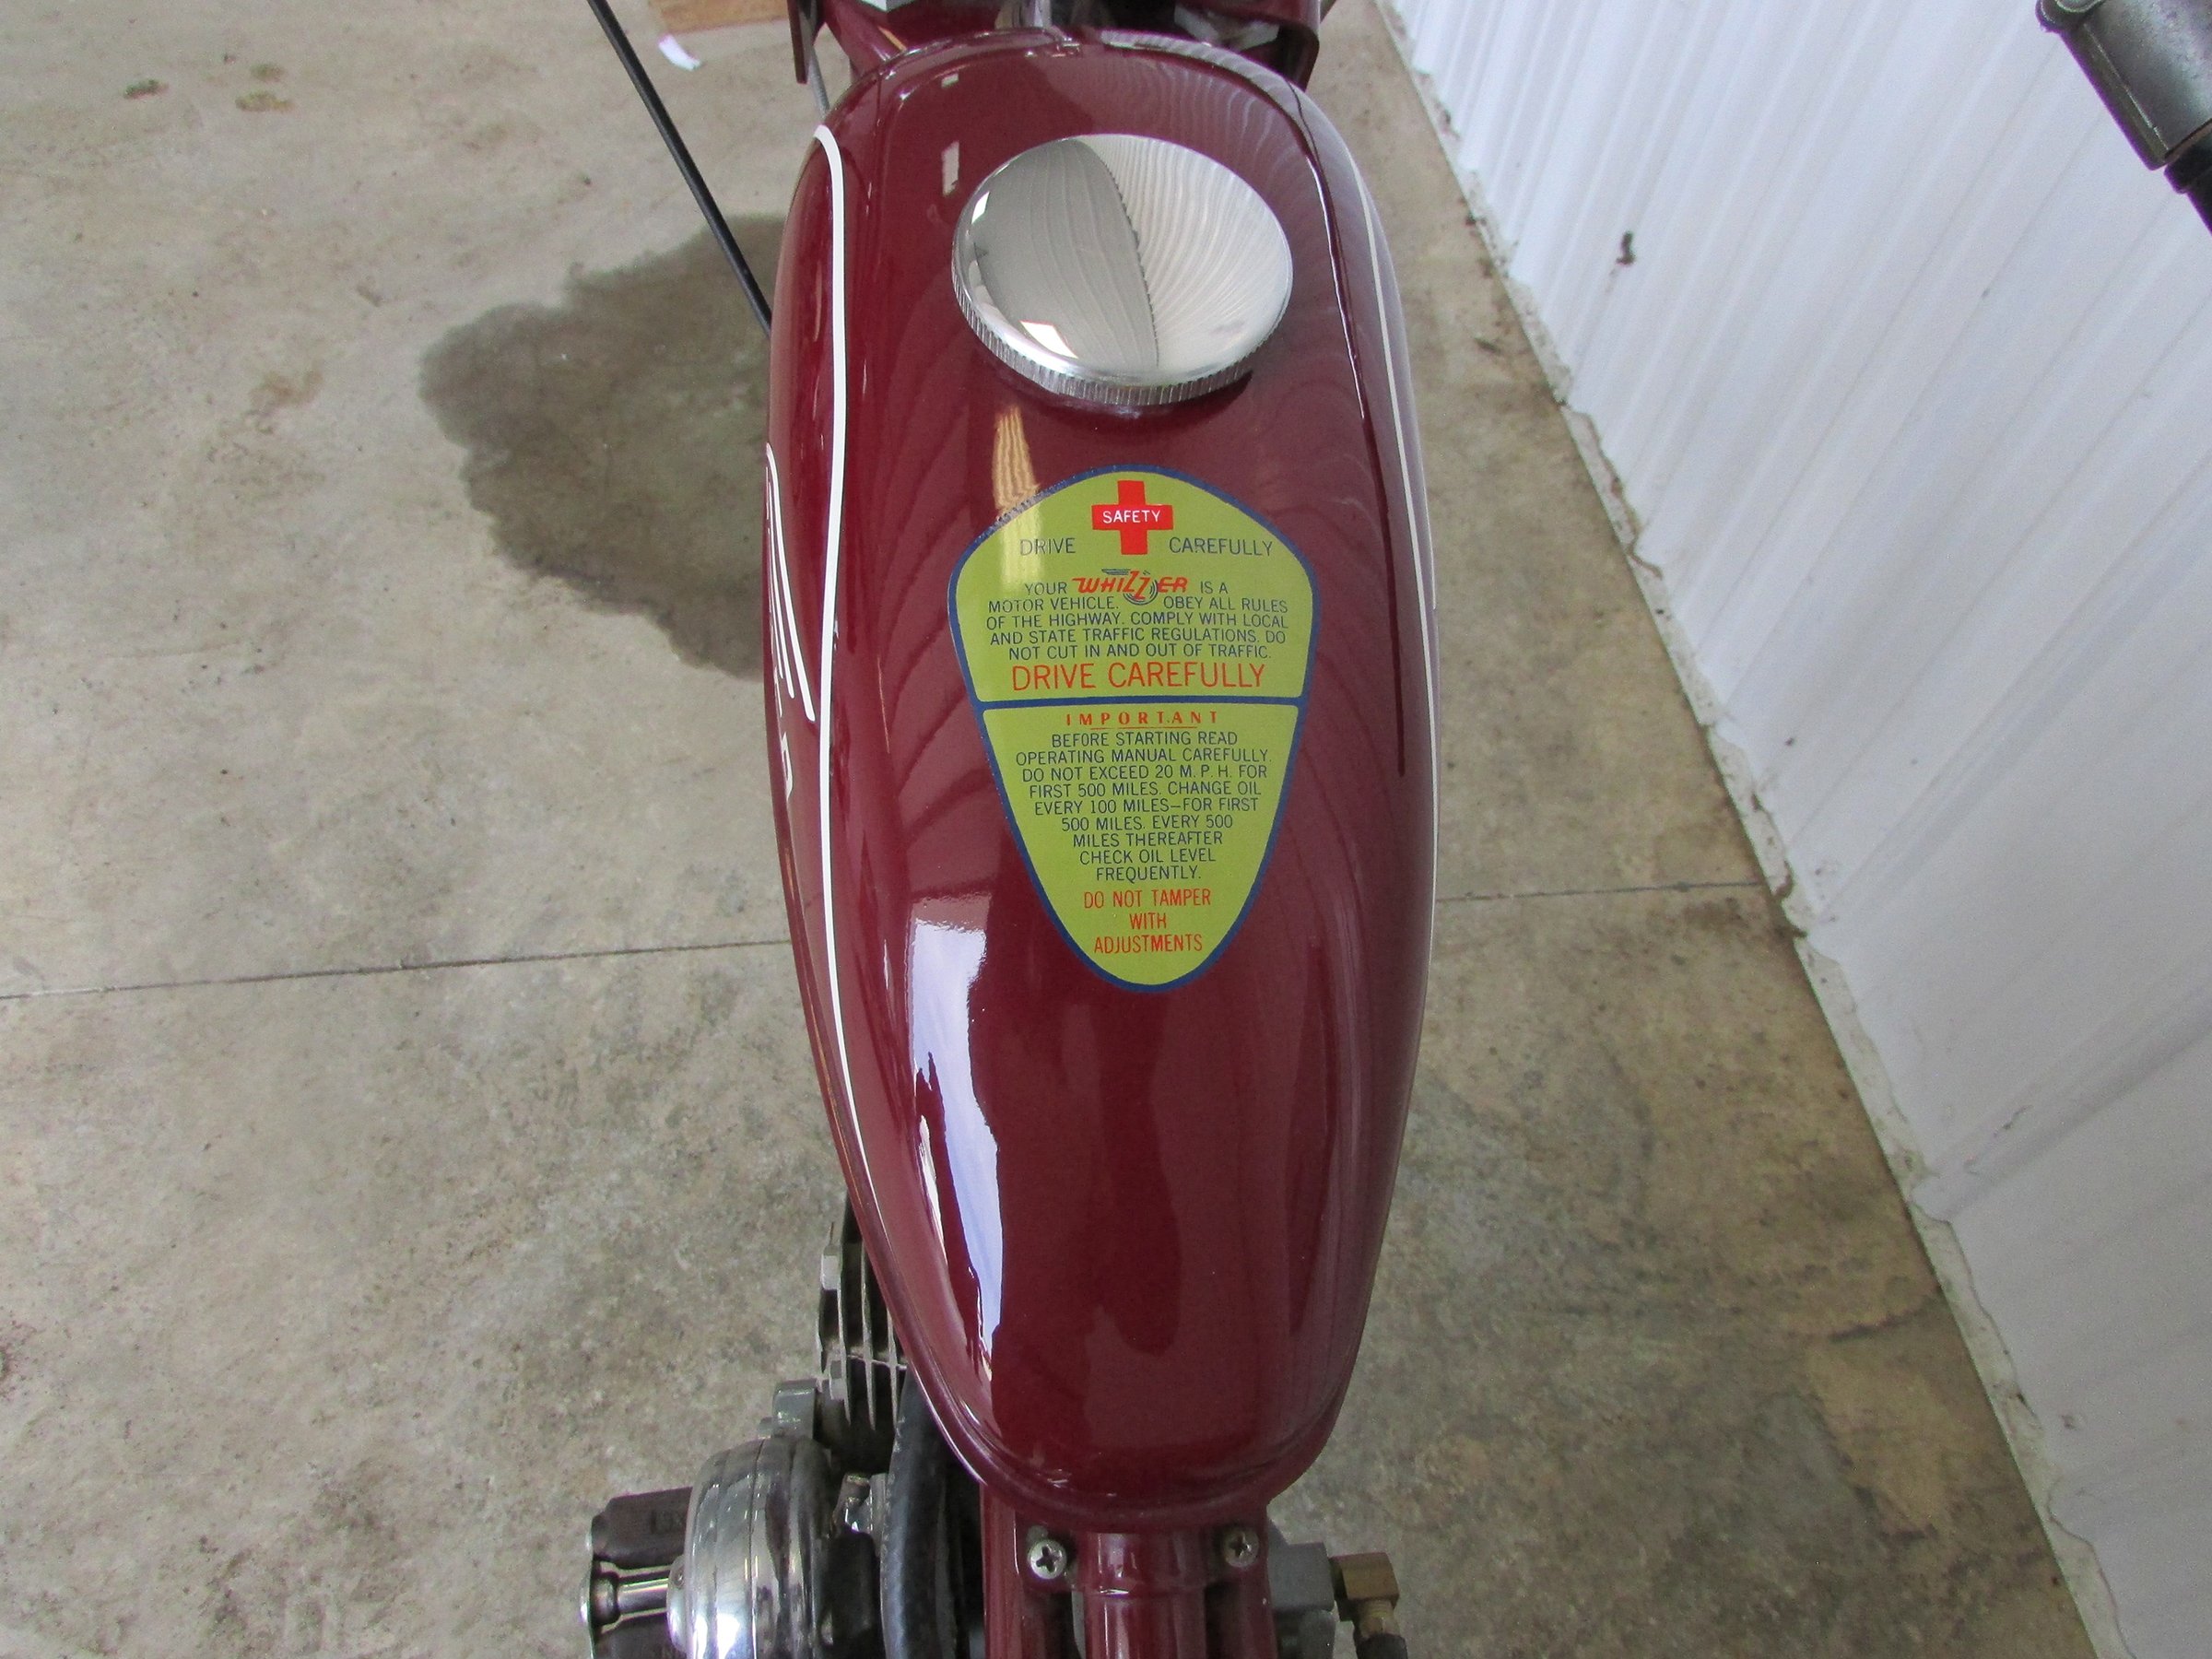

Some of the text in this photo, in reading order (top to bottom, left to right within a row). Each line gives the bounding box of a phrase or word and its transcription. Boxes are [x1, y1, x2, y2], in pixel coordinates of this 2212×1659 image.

[1102, 510, 1161, 524] SAFETY
[1020, 536, 1273, 556] DRIVE CAREFULLY
[1025, 582, 1067, 595] YOUR
[1200, 582, 1214, 594] IS
[1218, 582, 1228, 594] A
[989, 596, 1288, 613] MOTOR VEHICLE. OBEY ALL RULES
[986, 611, 1288, 629] OF THE HIGHWAY. COMPLY WITH LOCAL
[990, 628, 1286, 645] AND STATE TRAFFIC REGULATIONS. DO
[1008, 643, 1271, 660] NOT CUT IN AND OUT OF TRAFFIC.
[1012, 661, 1265, 691] DRIVE CAREFULLY
[1052, 732, 1238, 747] BEFORE STARTING READ
[1016, 748, 1272, 766] OPERATING MANUAL CAREFULLY.
[1023, 768, 1044, 782] DO
[1052, 767, 1082, 781] NOT
[1089, 765, 1148, 780] EXCEED
[1155, 765, 1173, 779] 20
[1239, 765, 1267, 778] FOR
[1030, 781, 1261, 798] FIRST 500 MILES. CHANGE OIL
[1035, 801, 1083, 815] EVERY
[1090, 799, 1116, 814] 100
[1218, 797, 1259, 812] FIRST
[1062, 815, 1233, 831] 500 MILES. EVERY 500
[1073, 831, 1223, 847] MILES THEREAFTER
[1079, 848, 1216, 865] CHECK OIL LEVEL
[1096, 865, 1201, 884] FREQUENTLY.
[1084, 888, 1211, 908] DO NOT TAMPER
[1129, 912, 1167, 929] WITH
[1094, 934, 1203, 954] ADJUSTMENTS
